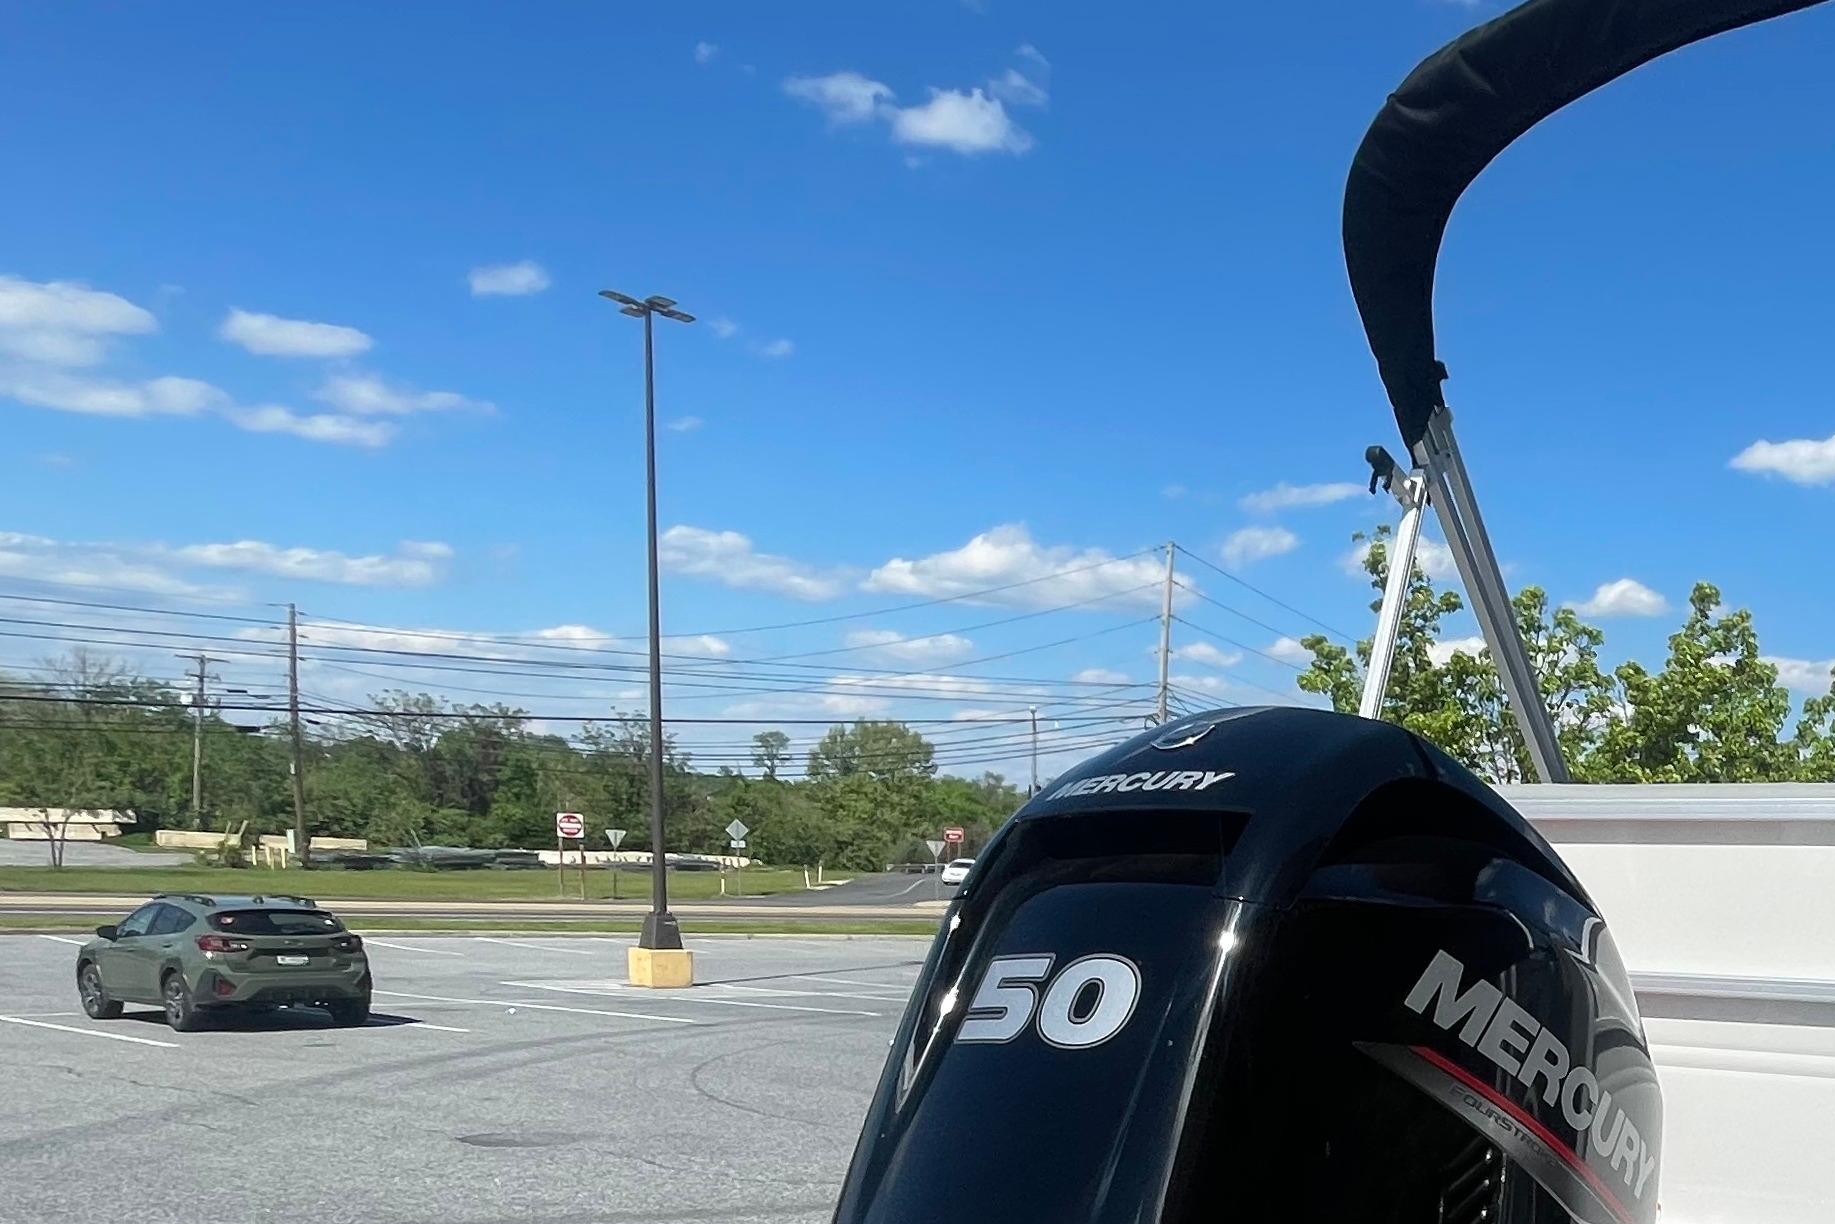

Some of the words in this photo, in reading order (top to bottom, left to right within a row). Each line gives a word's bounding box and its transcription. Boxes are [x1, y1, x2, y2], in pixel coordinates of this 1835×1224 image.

[1046, 770, 1237, 801] MERCURY
[953, 952, 1143, 1050] 50
[1404, 949, 1655, 1200] MERCURY
[1448, 1083, 1557, 1167] FOURSTRO
